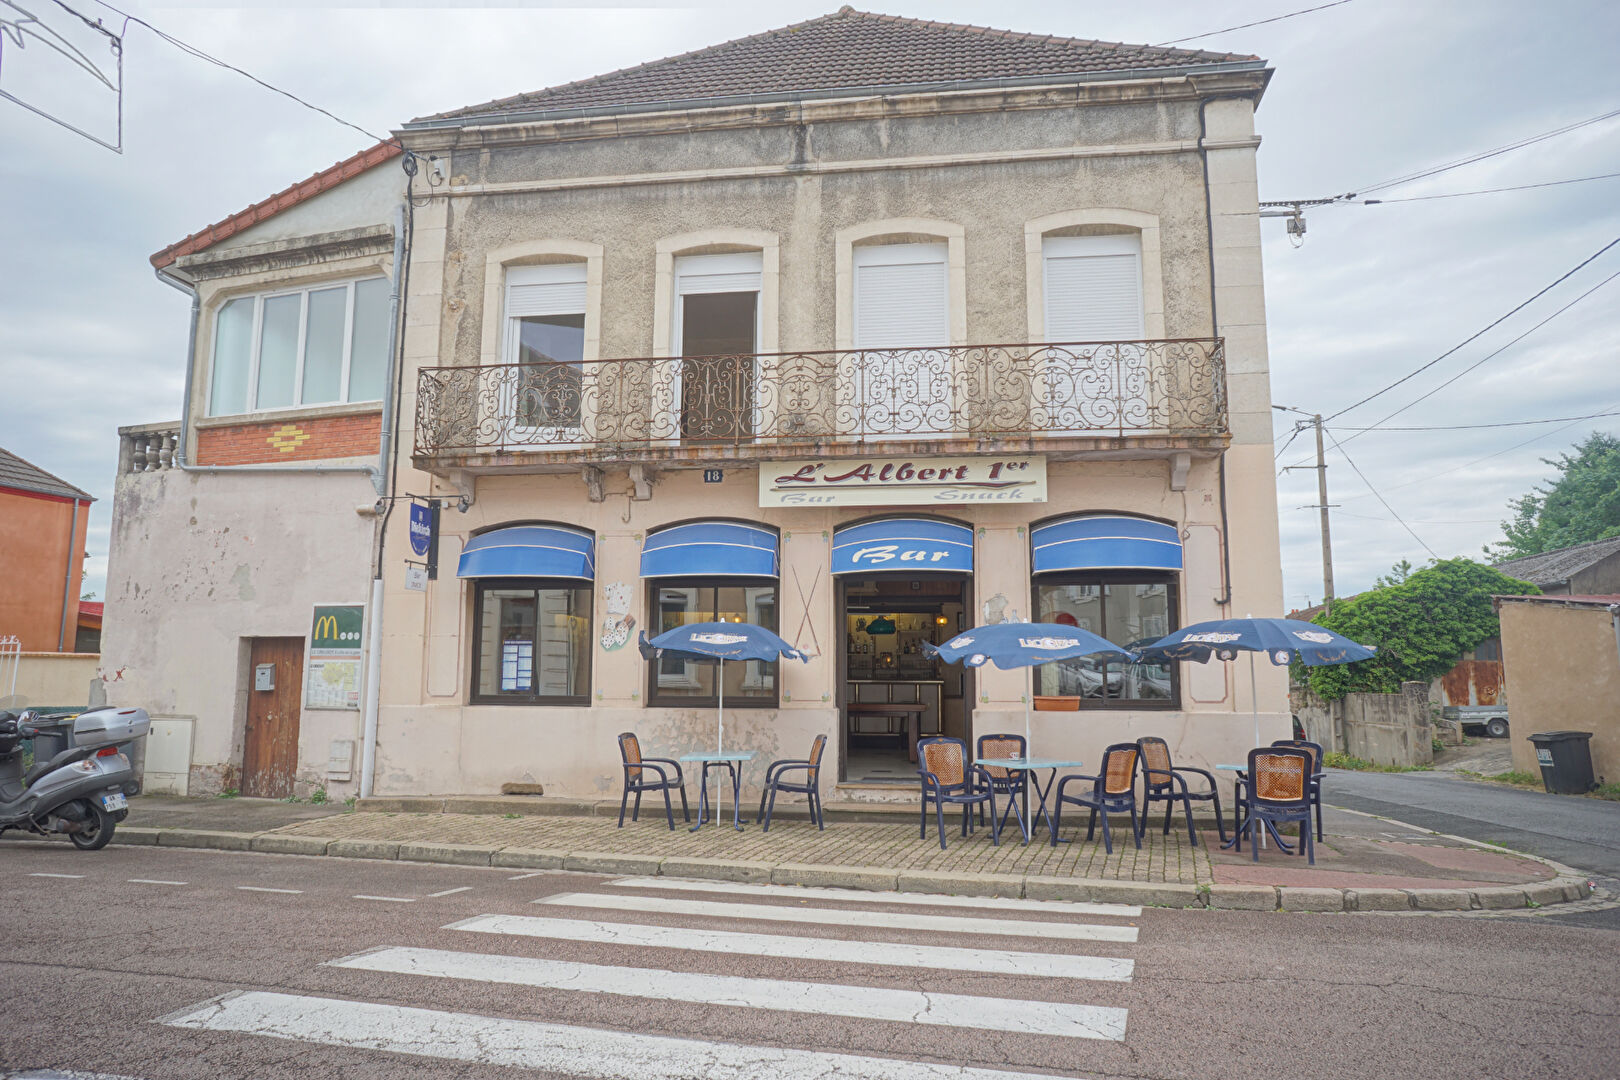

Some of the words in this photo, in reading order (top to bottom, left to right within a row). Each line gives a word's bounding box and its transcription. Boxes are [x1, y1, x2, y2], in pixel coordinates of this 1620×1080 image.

[707, 470, 720, 481] 18
[987, 460, 1031, 480] 1er
[780, 491, 836, 504] Bar
[933, 488, 1026, 502] Snack
[852, 545, 949, 564] Bar
